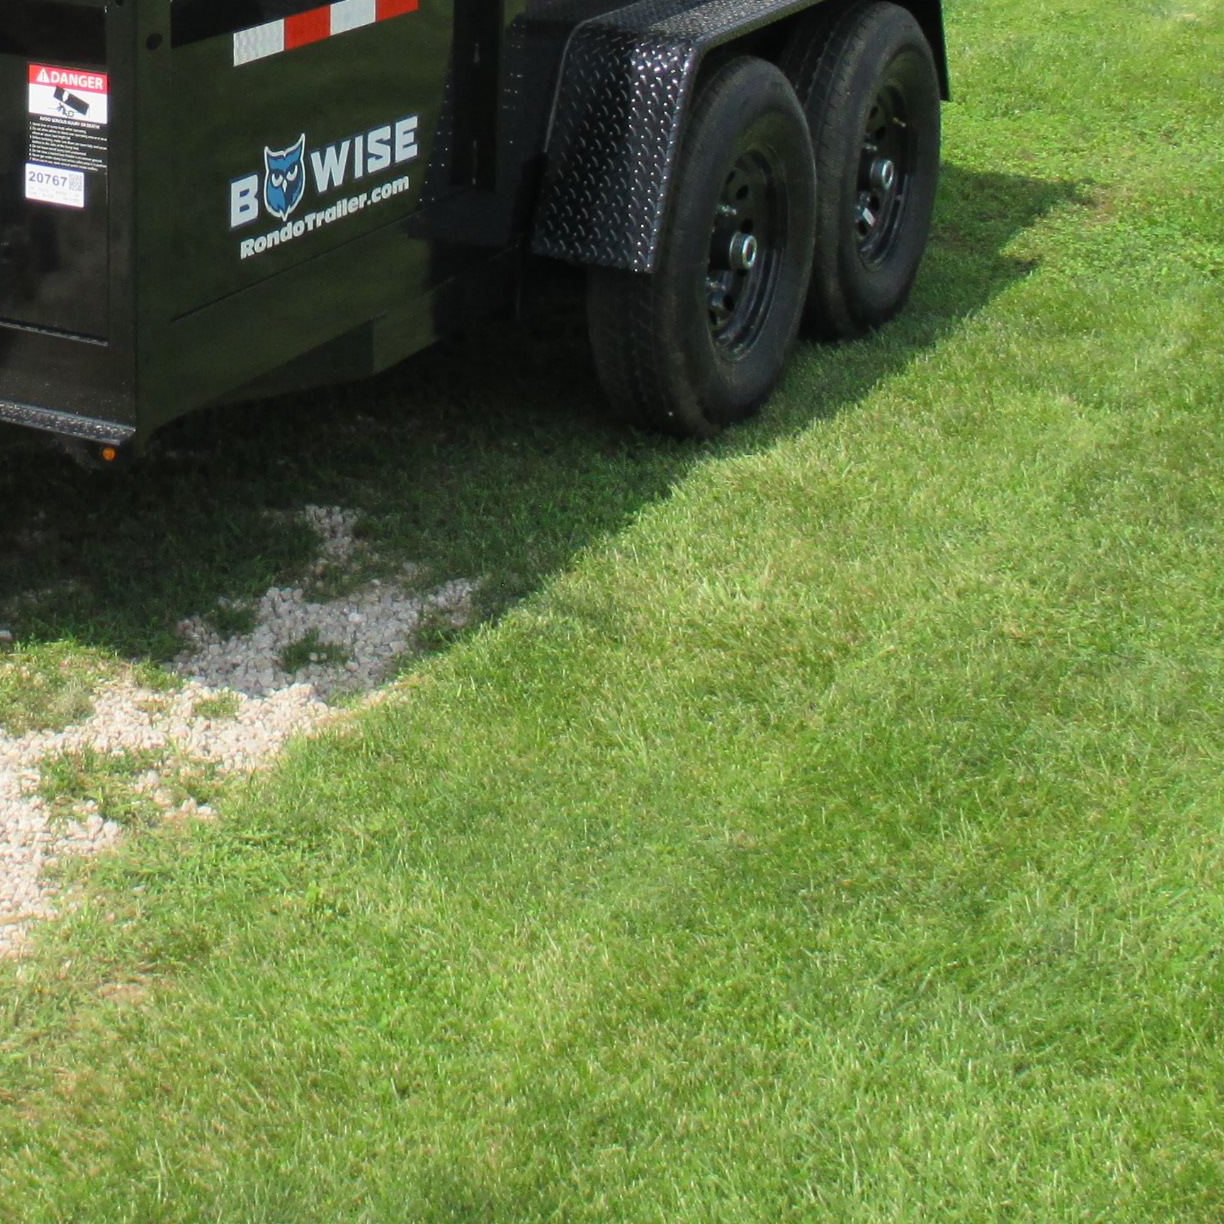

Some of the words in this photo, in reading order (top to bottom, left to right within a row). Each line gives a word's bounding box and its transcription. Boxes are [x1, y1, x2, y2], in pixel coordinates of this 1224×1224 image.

[50, 72, 104, 90] DANGER
[28, 171, 68, 187] 20767
[240, 175, 410, 259] RondoTrailer.com
